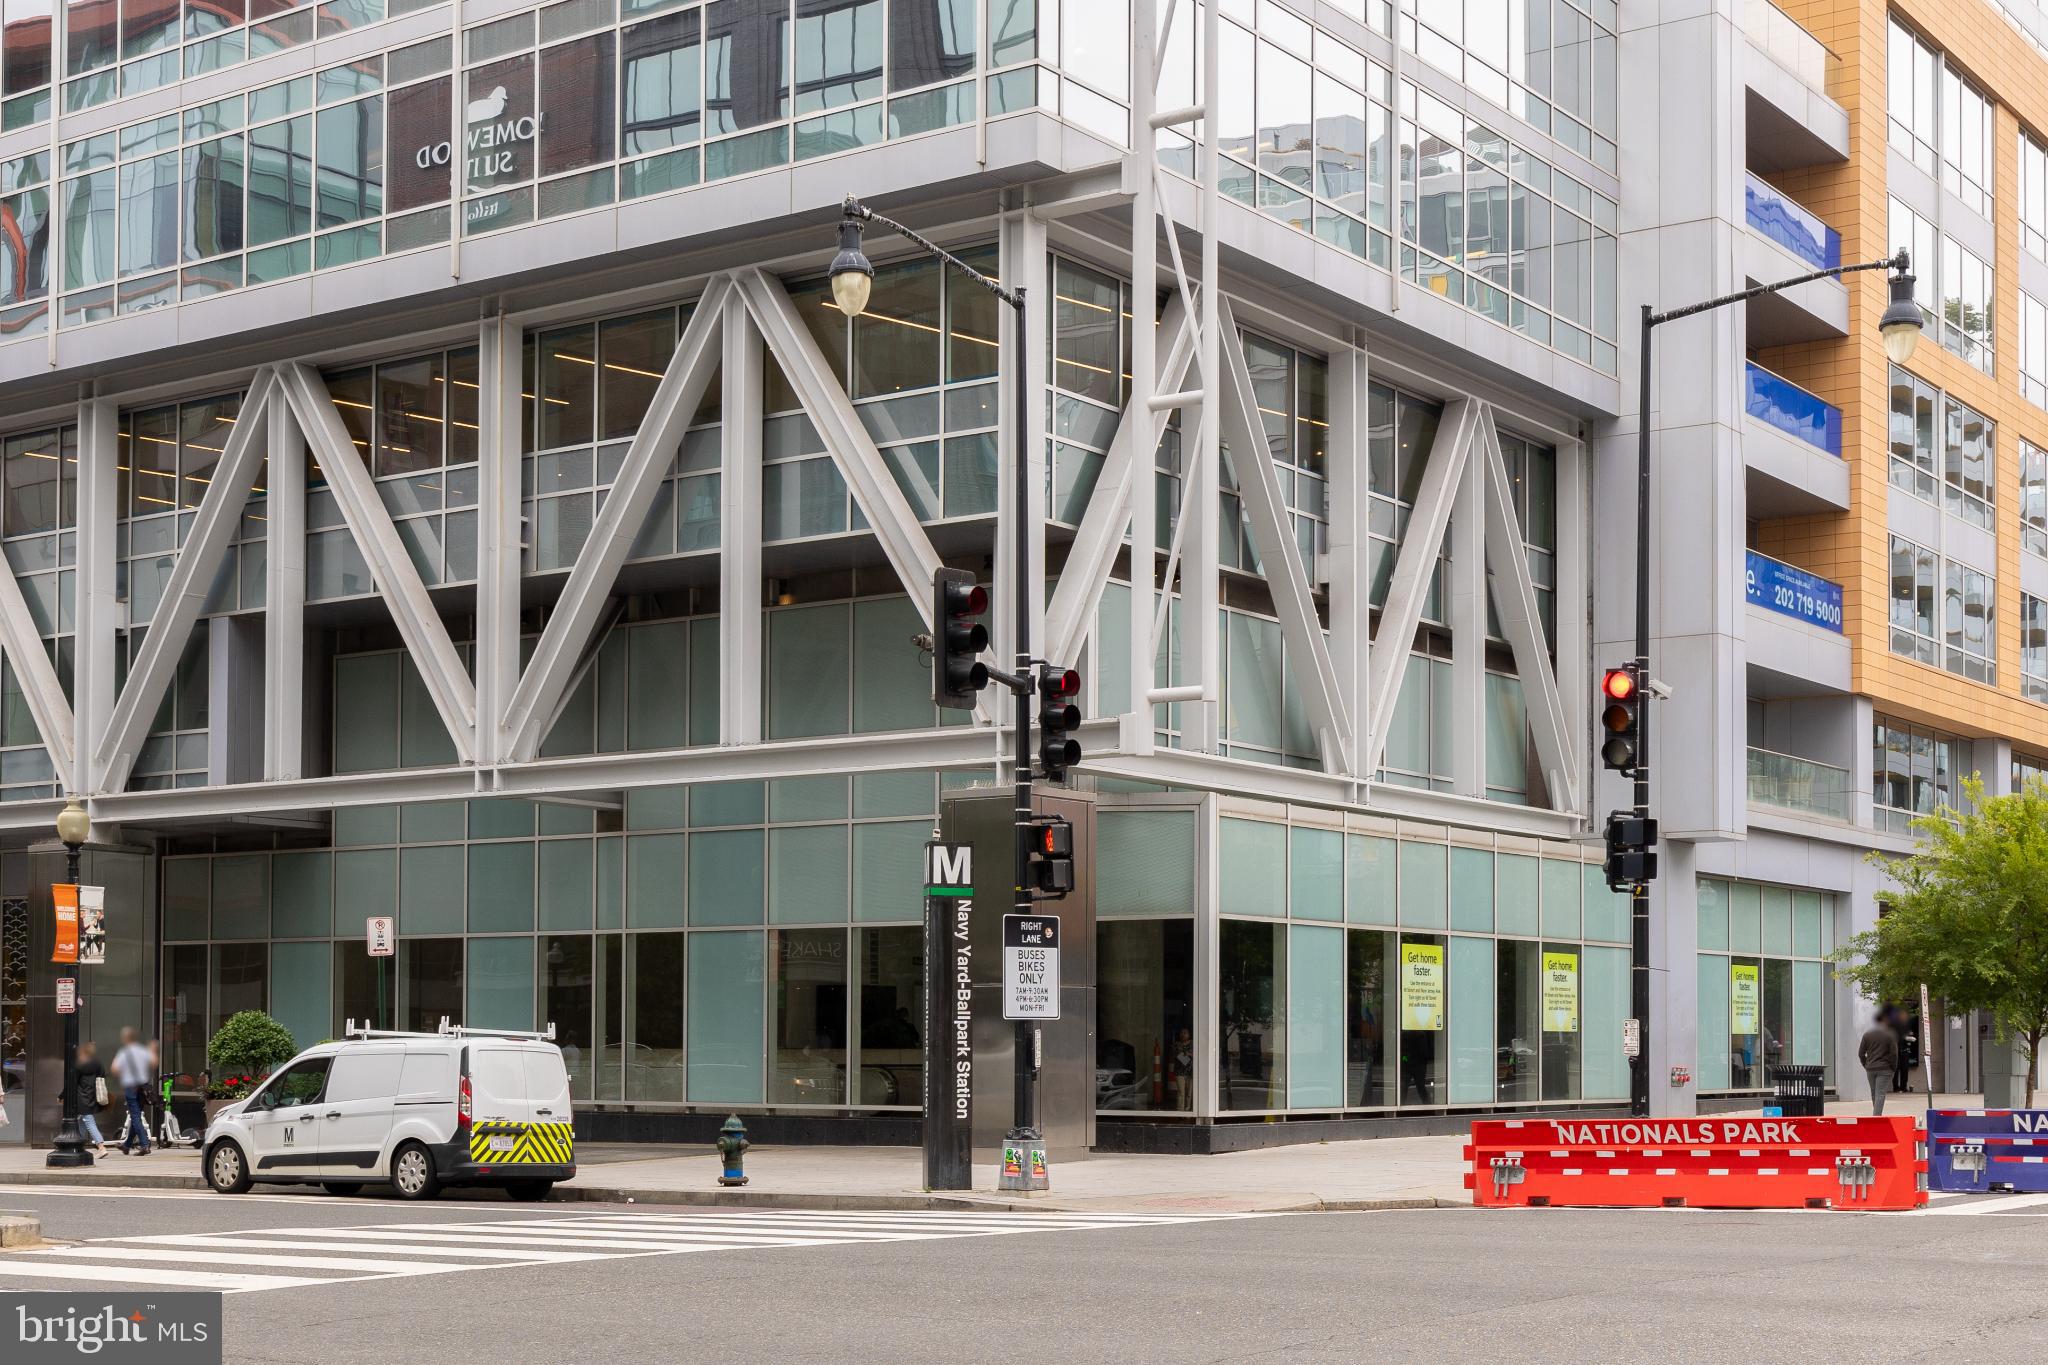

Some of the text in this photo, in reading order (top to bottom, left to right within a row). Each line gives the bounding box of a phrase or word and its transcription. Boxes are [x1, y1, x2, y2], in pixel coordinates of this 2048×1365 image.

[1774, 585, 1841, 626] 202 719 5000
[933, 845, 972, 885] M
[57, 911, 77, 921] HOME
[1020, 921, 1043, 931] RIGHT
[1021, 934, 1042, 944] LANE
[1017, 949, 1046, 960] BUSES
[1408, 952, 1438, 964] Get home
[1018, 961, 1045, 972] BIKES
[1413, 964, 1432, 977] faster.
[1548, 960, 1572, 971] Get home
[1019, 973, 1044, 984] ONLY
[953, 899, 972, 1119] Navy Yard-Ballpark Station
[284, 1127, 295, 1143] M
[1556, 1122, 1802, 1144] NATIONALS PARK
